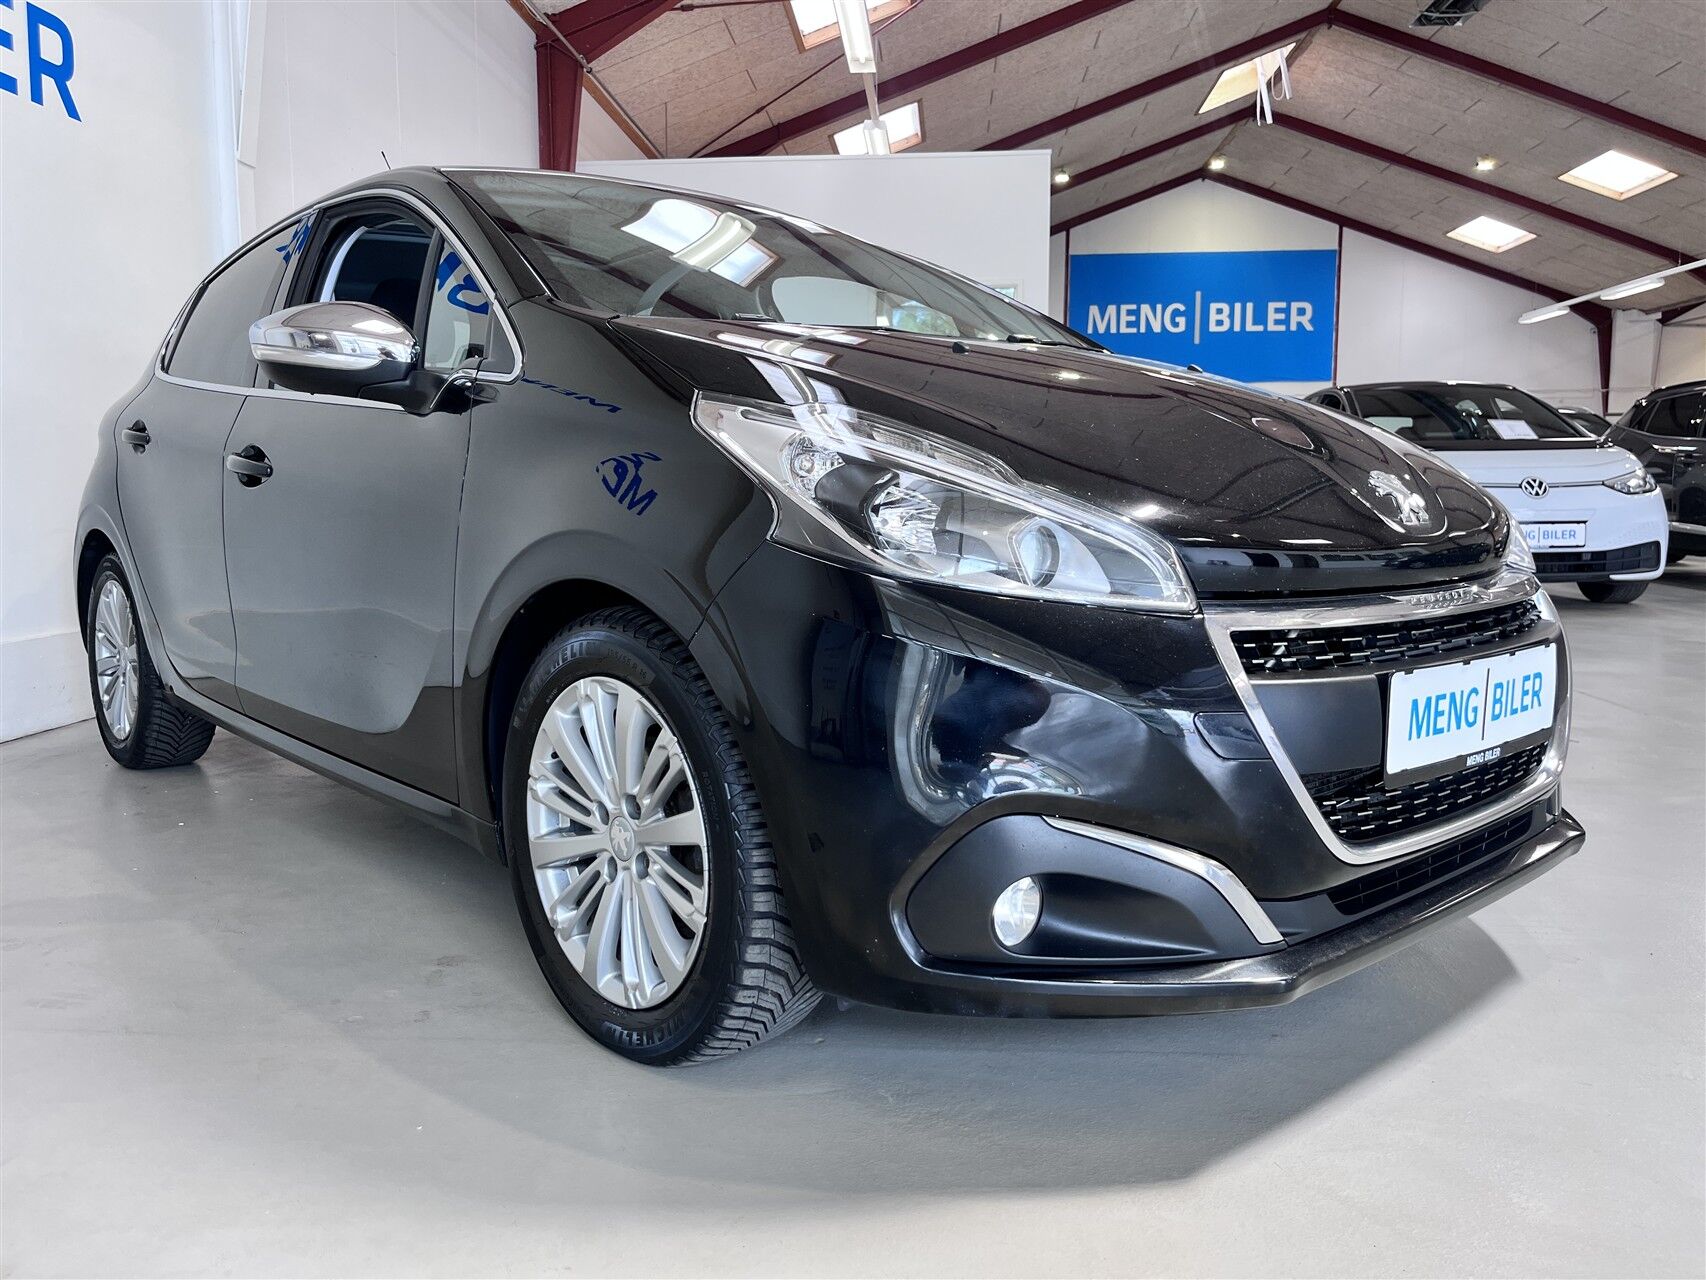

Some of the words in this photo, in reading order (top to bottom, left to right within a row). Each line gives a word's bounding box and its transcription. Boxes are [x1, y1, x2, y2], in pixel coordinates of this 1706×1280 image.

[1087, 303, 1186, 334] MENG
[1209, 301, 1314, 333] BILER
[1542, 529, 1576, 540] BILER
[1408, 686, 1479, 742] MENG
[1491, 671, 1543, 722] BILER
[1466, 752, 1484, 766] MENG
[1484, 747, 1500, 761] BILER
